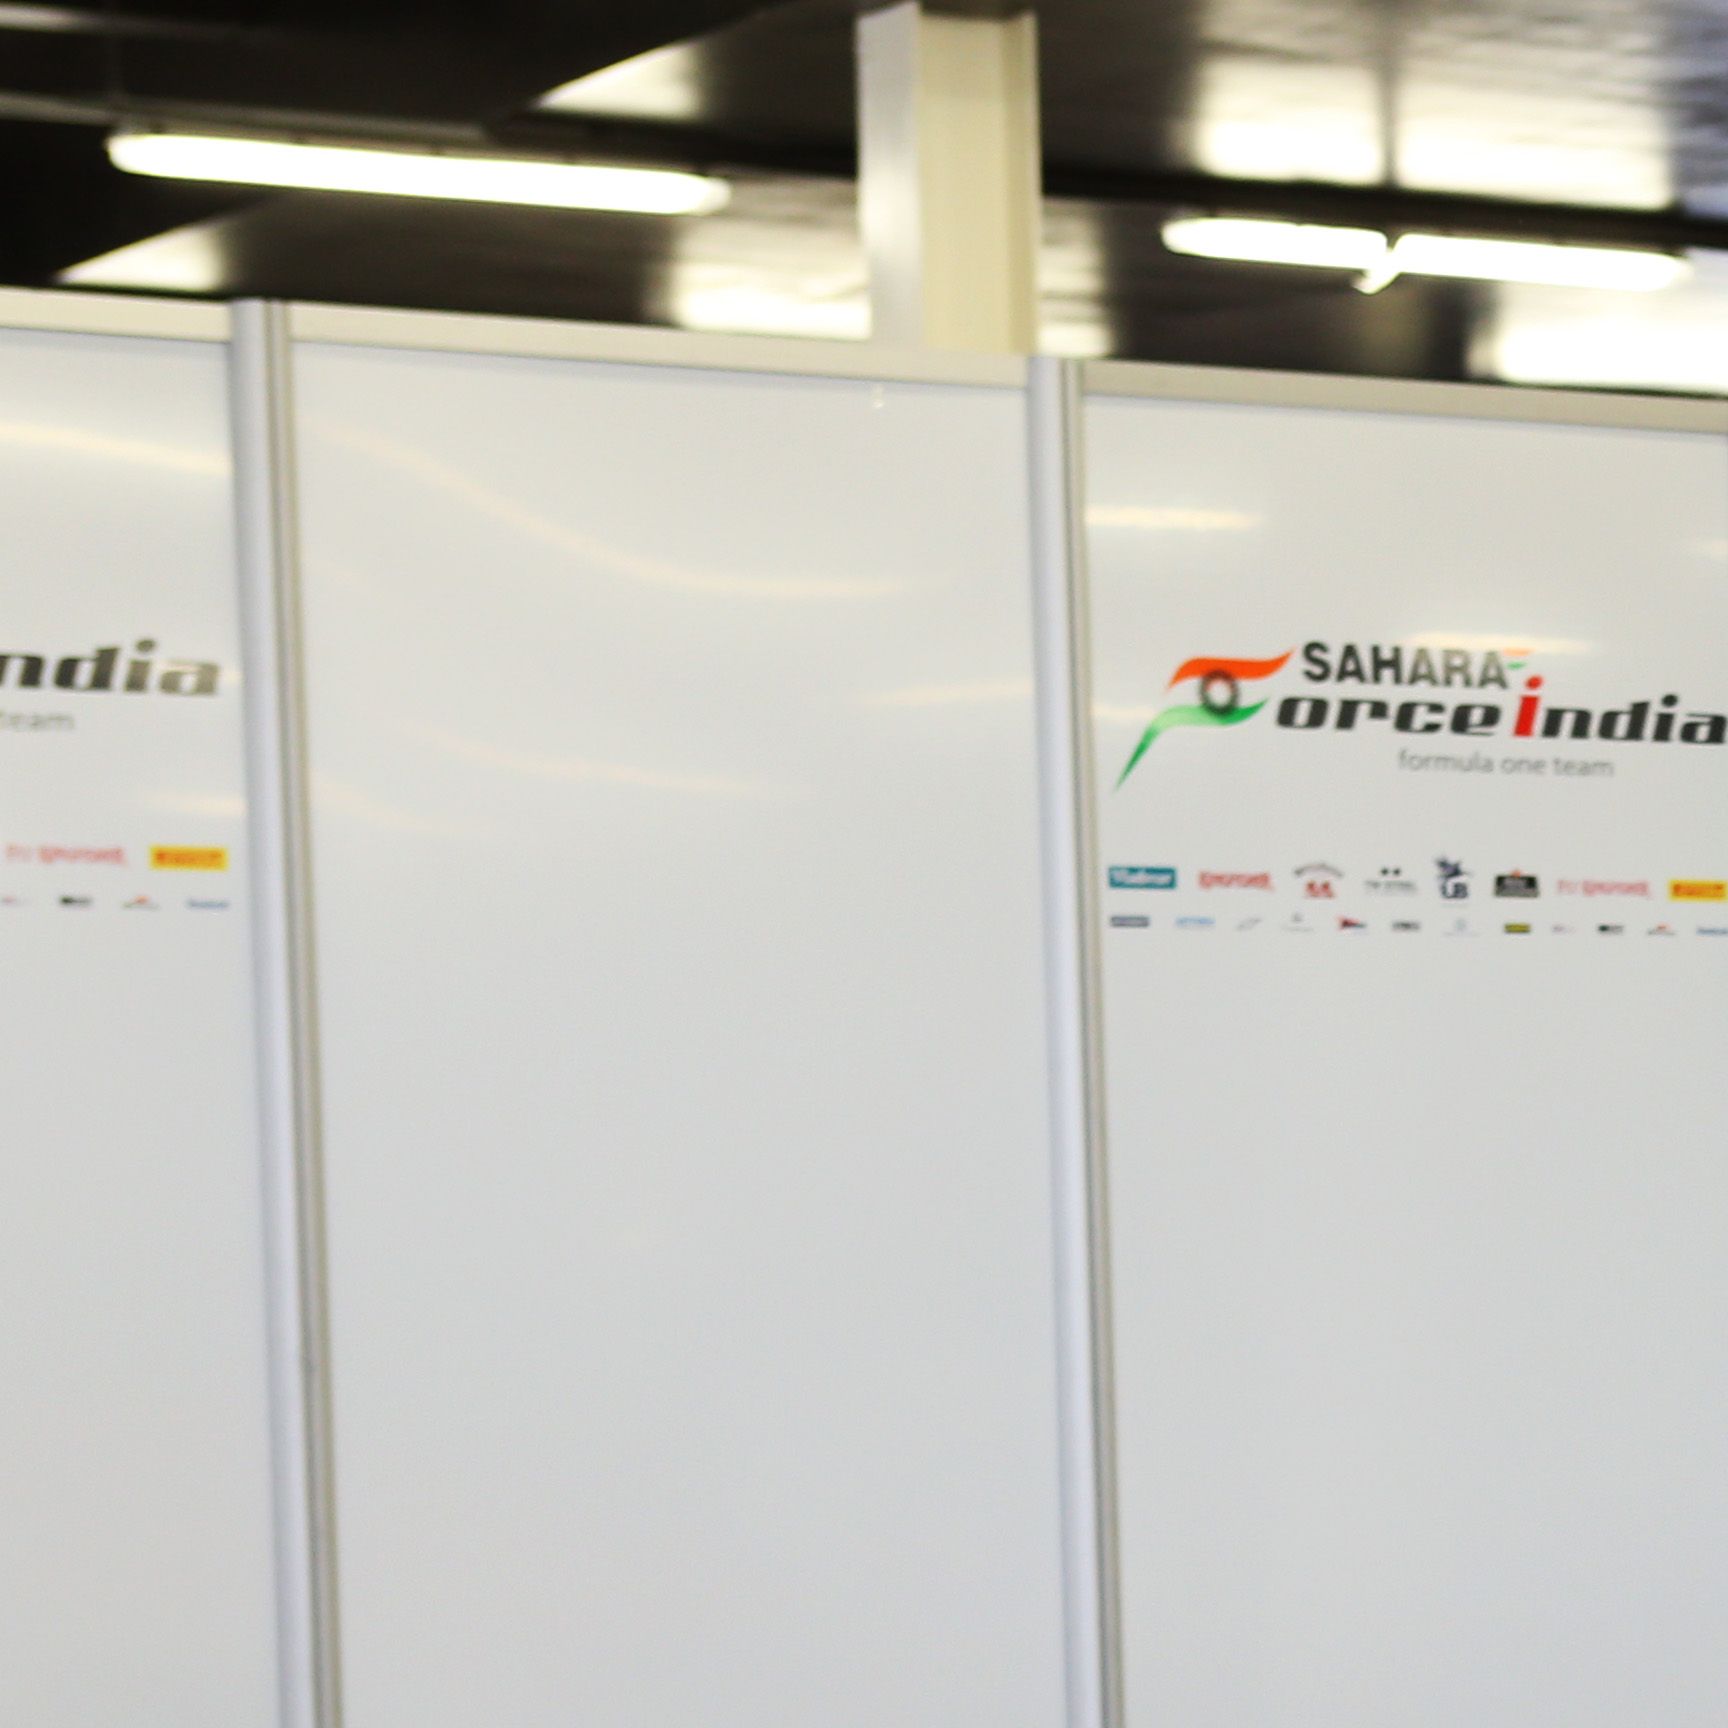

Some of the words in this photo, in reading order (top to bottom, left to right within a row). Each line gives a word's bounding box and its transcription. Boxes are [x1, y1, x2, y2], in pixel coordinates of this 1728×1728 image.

[1302, 641, 1508, 690] SAHARA
[1399, 748, 1494, 775] formula
[1502, 757, 1548, 775] one
[1555, 755, 1614, 777] team
